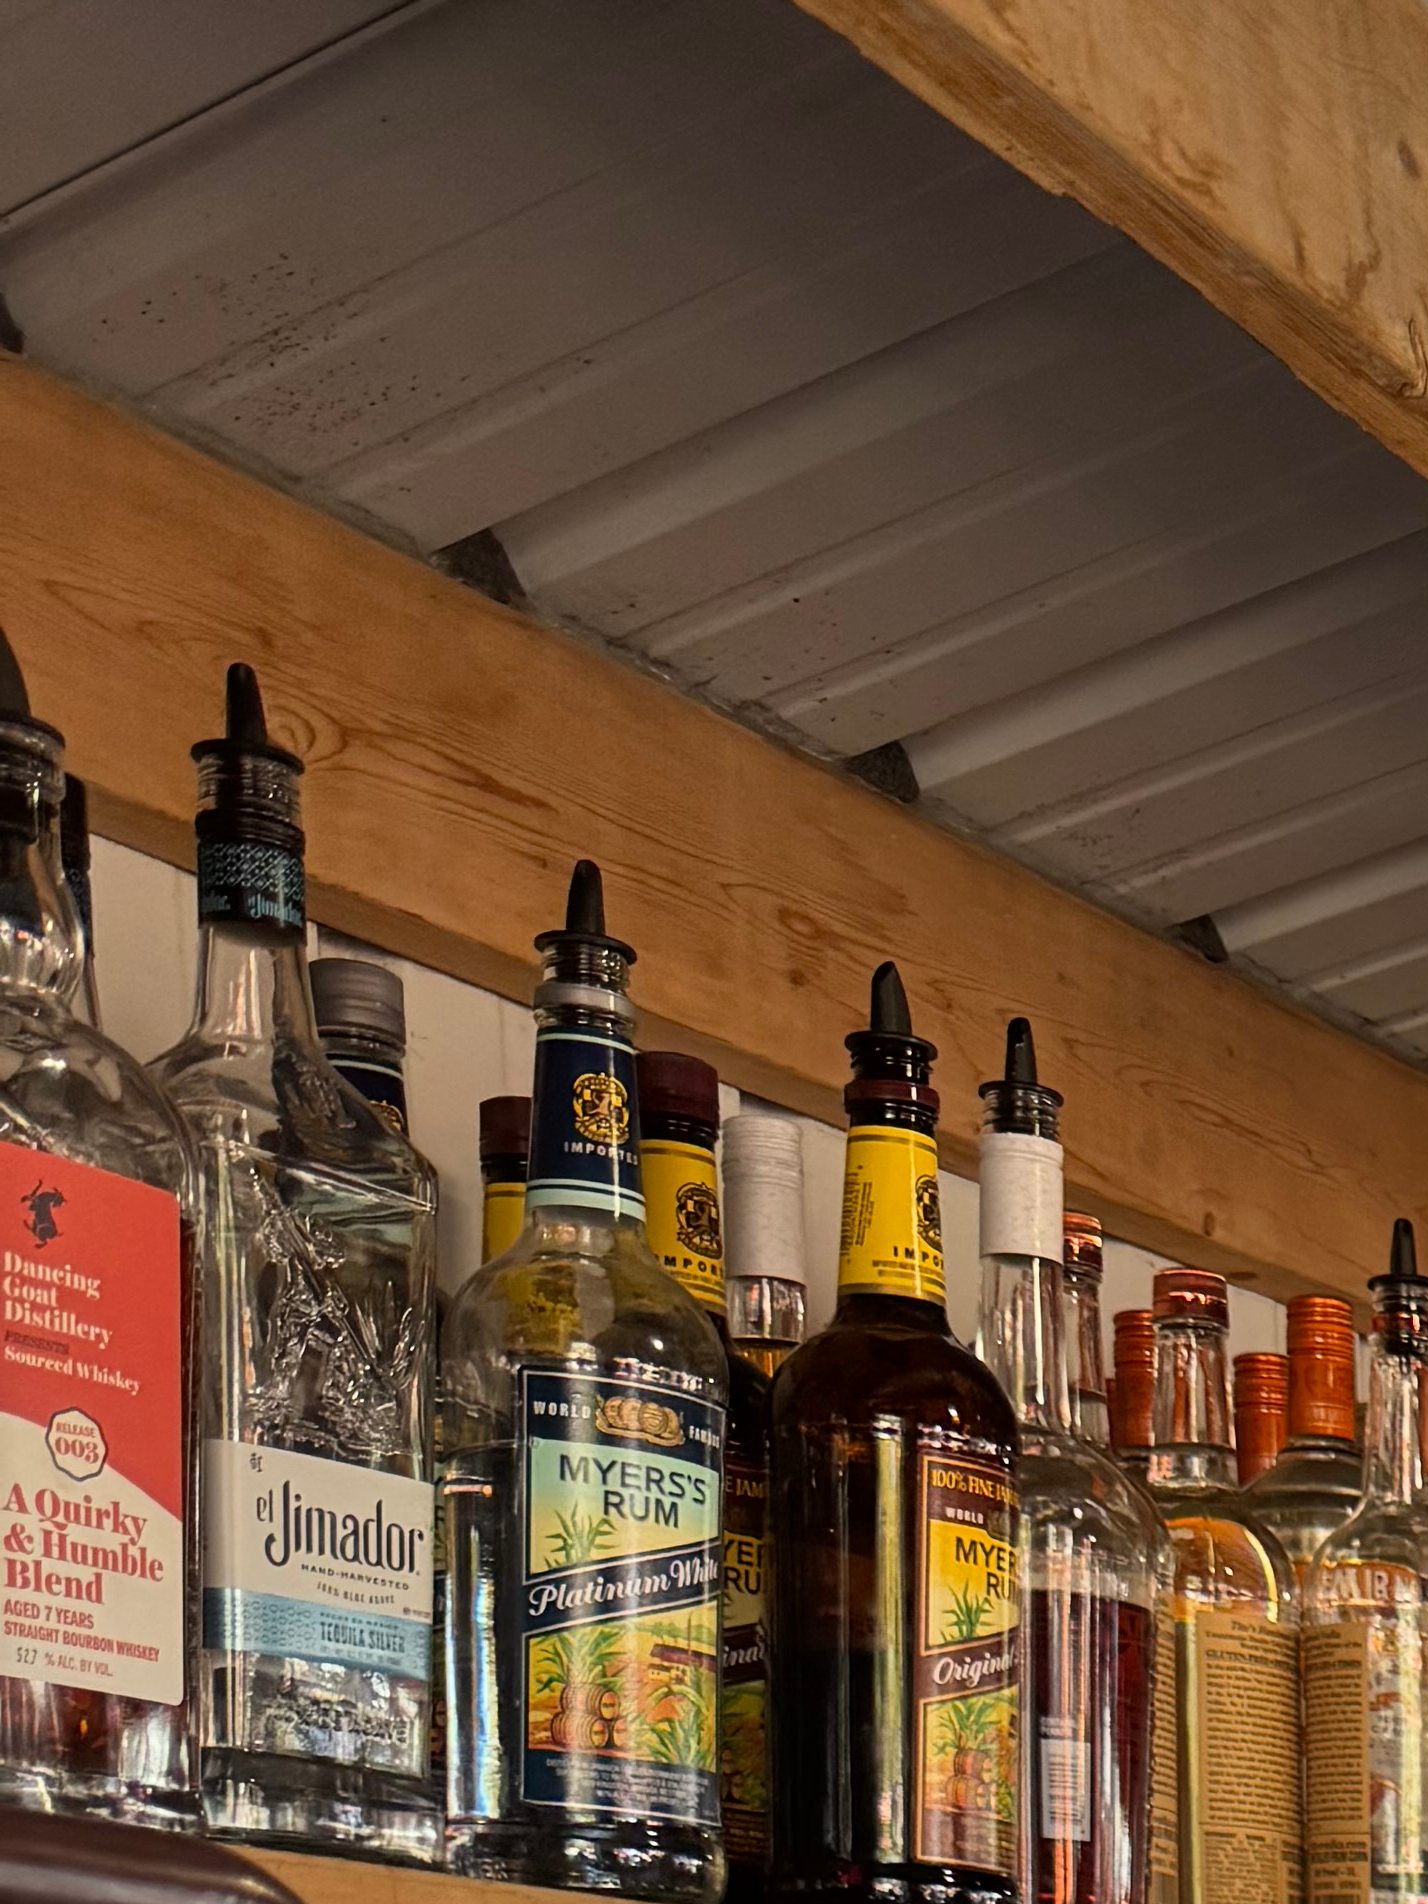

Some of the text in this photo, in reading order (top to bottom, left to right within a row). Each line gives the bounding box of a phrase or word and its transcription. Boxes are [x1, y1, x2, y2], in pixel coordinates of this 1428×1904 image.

[2, 1251, 101, 1299] Dancing
[3, 1275, 58, 1307] Goat
[3, 1300, 112, 1349] Distillery
[4, 1345, 140, 1396] Sourced Whiskey
[55, 1421, 97, 1439] RELEASE
[533, 1400, 592, 1420] WORLD
[54, 1436, 100, 1464] 003
[559, 1453, 707, 1506] MYERS'S
[930, 1467, 995, 1500] 100% FINE
[2, 1482, 148, 1547] A Quirky
[256, 1480, 421, 1574] el Jimador
[604, 1489, 680, 1529] RUM
[945, 1506, 985, 1525] WORLD
[3, 1522, 165, 1583] & Humble
[4, 1557, 104, 1606] Blend
[301, 1563, 410, 1591] HAND-HARVESTED
[528, 1572, 671, 1617] Platinum
[4, 1599, 94, 1630] AGED 7 YEARS
[4, 1620, 160, 1663] STRAIGHT BOURBON WHISKEY
[319, 1621, 406, 1654] TEQUILA SILVER
